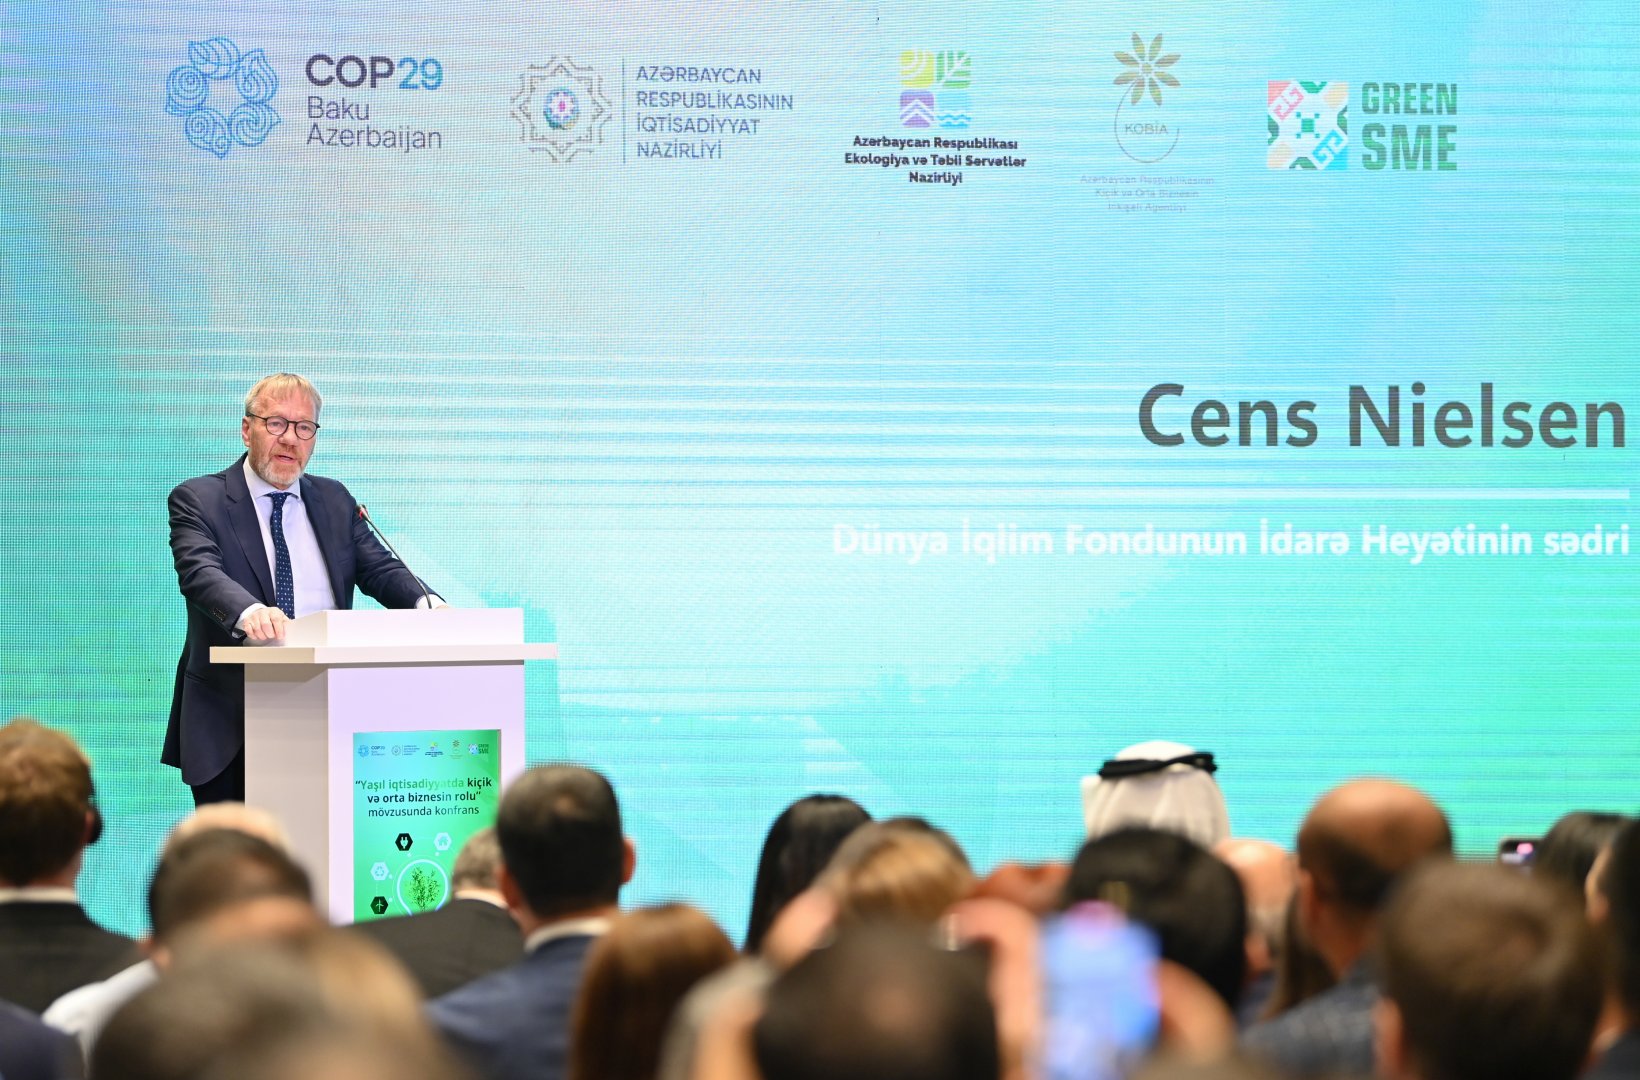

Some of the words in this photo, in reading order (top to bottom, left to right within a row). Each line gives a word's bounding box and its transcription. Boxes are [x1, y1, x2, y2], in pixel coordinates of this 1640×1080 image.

[305, 54, 444, 90] COP29
[636, 65, 761, 84] AZƏRBAYCAN
[307, 95, 370, 121] Baku
[636, 89, 793, 110] RESPUBLİKASININ
[1361, 81, 1458, 115] GREEN
[637, 112, 761, 134] İQTİSADİYYAT
[306, 122, 442, 153] Azerbaijan
[853, 135, 931, 151] Azərbaycan
[933, 136, 1018, 151] Respublikası
[1361, 122, 1458, 171] SME
[637, 138, 722, 159] NAZİRLİYİ
[844, 152, 910, 168] Ekologiya
[912, 157, 928, 166] və
[930, 154, 962, 166] Təbii
[965, 155, 1027, 167] Sərvətlər
[909, 171, 963, 186] Nazirliyi
[1138, 382, 1318, 448] Cens
[1348, 381, 1626, 448] Nielsen
[832, 522, 948, 565] Dünya
[961, 517, 1055, 564] İqlim
[1064, 522, 1247, 556] Fondunun
[1259, 517, 1350, 556] İdarə
[1362, 522, 1533, 566] Heyətinin
[1543, 522, 1630, 556] sədri
[467, 777, 492, 790] kiçik
[367, 795, 379, 803] və
[382, 793, 405, 803] orta
[408, 792, 452, 802] biznesin
[368, 806, 432, 817] mövzusunda
[434, 805, 480, 816] konfrans
